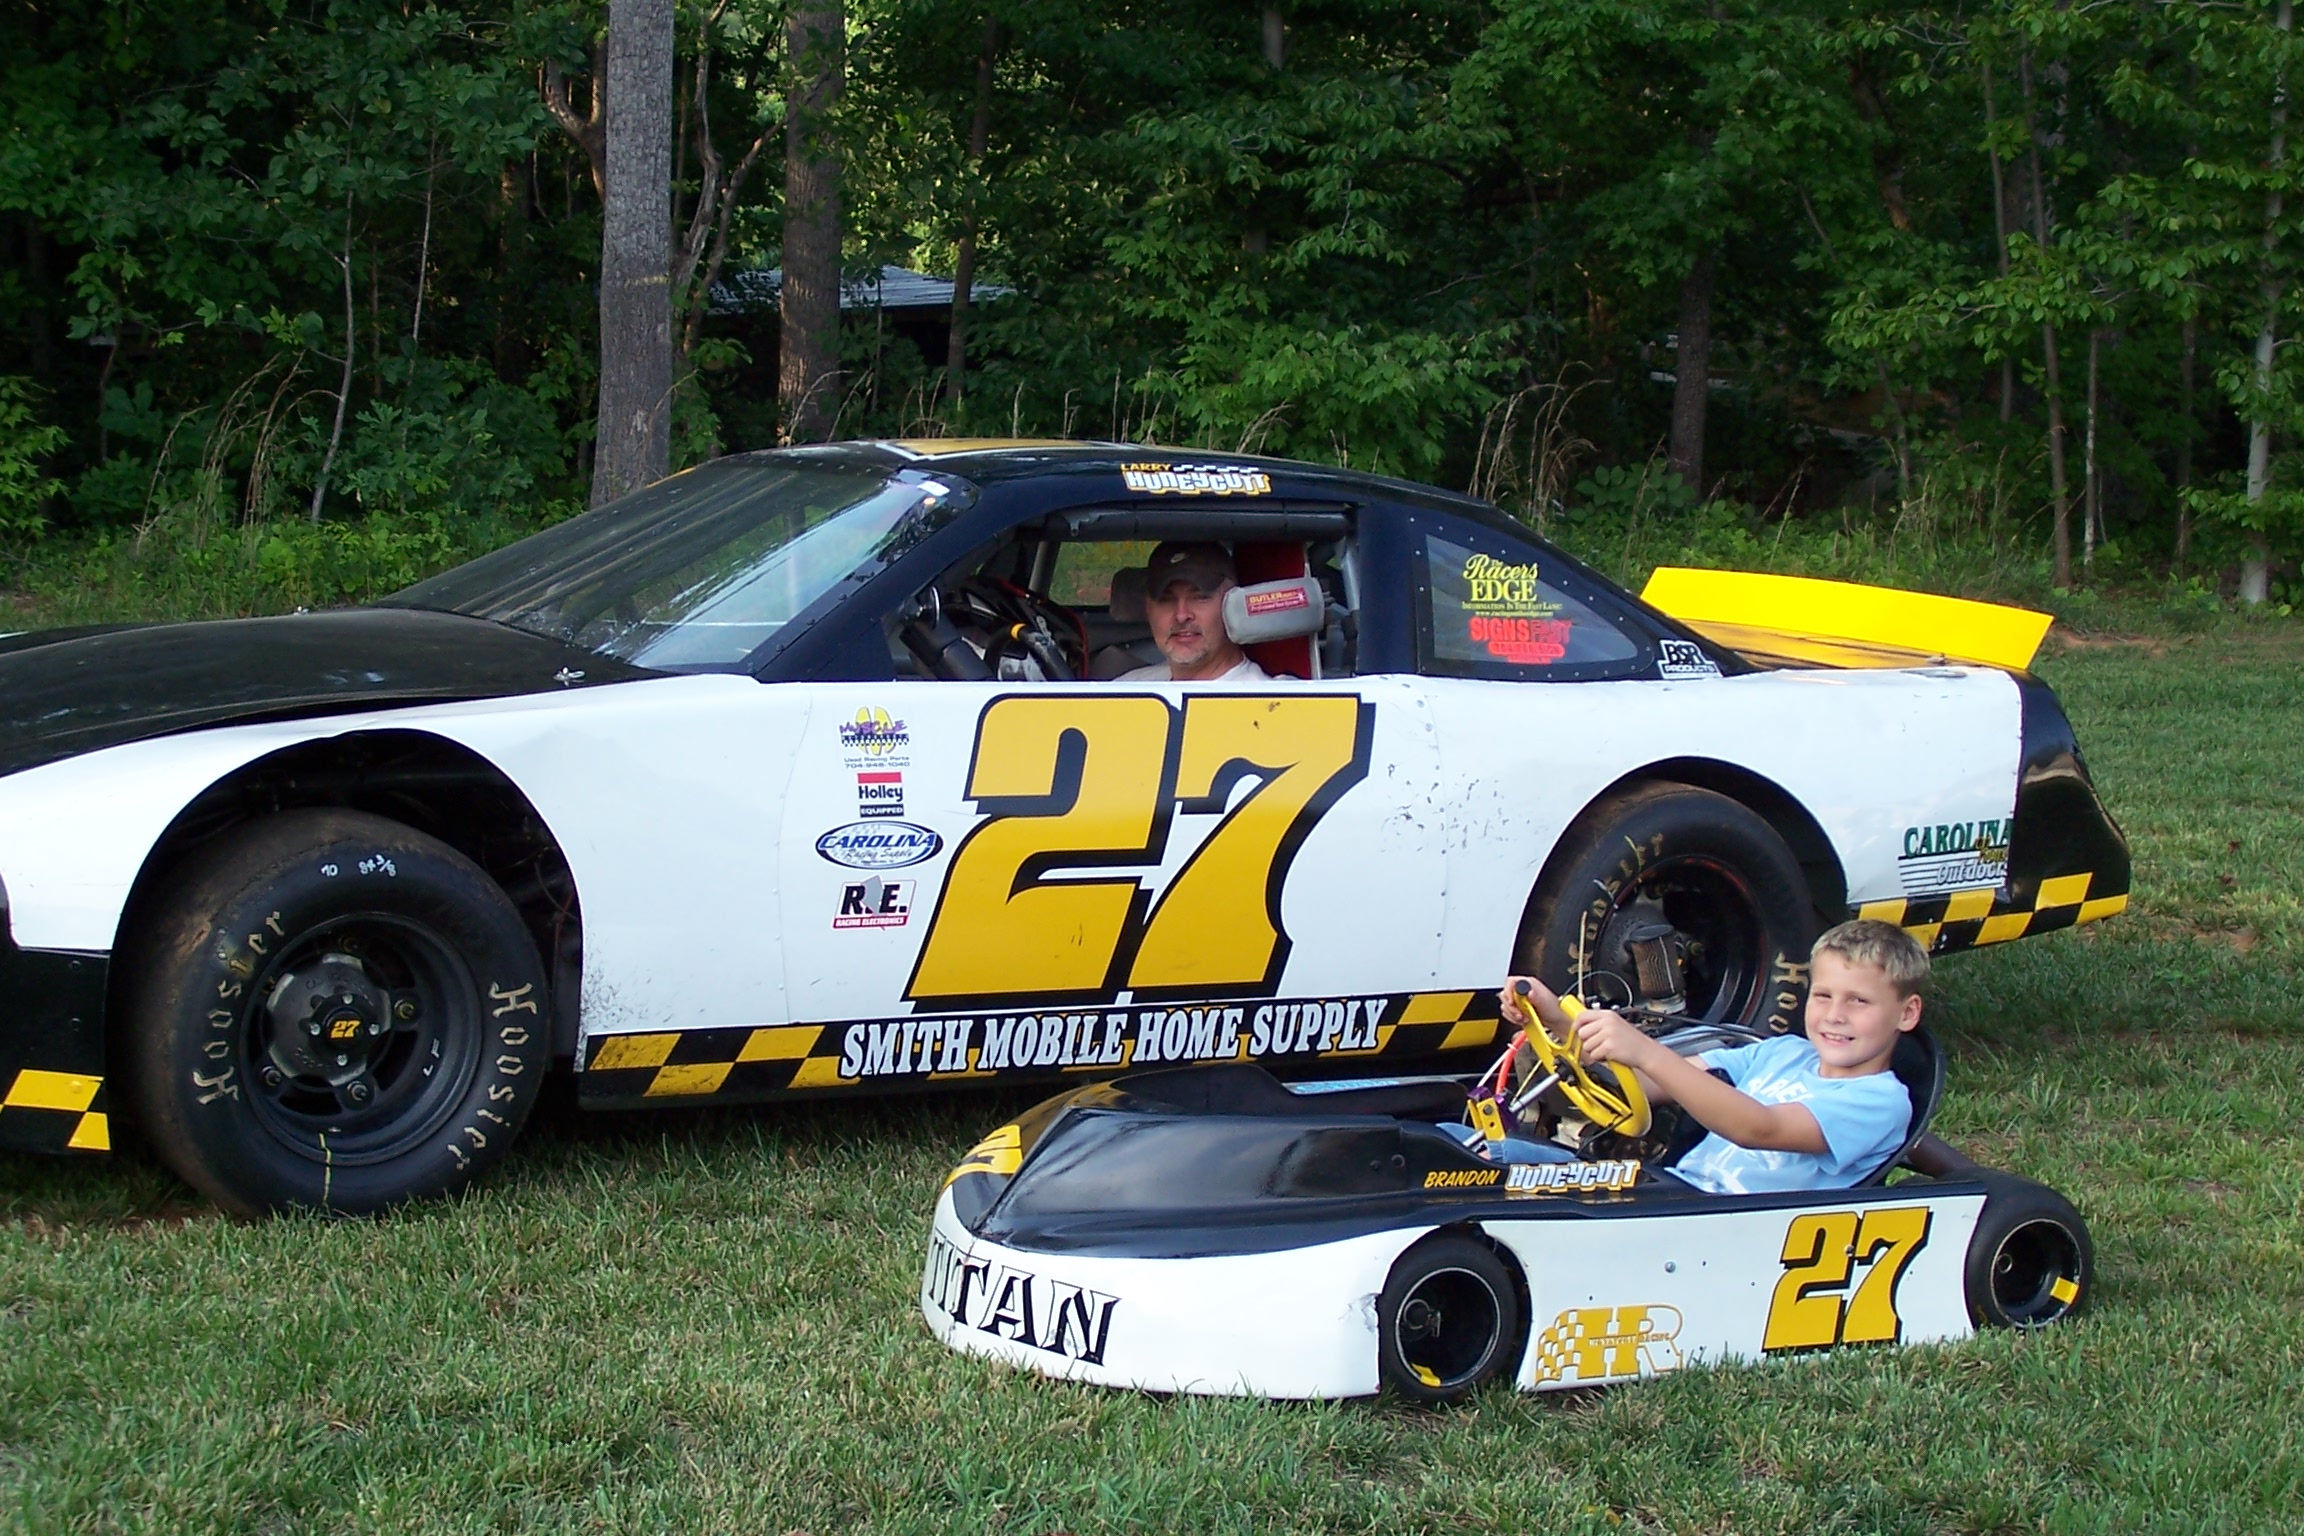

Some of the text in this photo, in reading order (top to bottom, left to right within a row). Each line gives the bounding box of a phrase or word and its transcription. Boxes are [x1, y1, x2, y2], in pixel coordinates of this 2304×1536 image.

[1120, 463, 1172, 471] LARRY
[1463, 554, 1539, 580] Racers
[1470, 580, 1538, 602] EDGE
[1663, 643, 1706, 666] BSR
[1663, 664, 1716, 674] PRODUCTS
[858, 785, 903, 802] Holley
[861, 806, 904, 815] EQUIPPED
[819, 834, 936, 849] CAROLINA
[902, 692, 1373, 1012] 27
[845, 849, 878, 859] Racing
[835, 916, 905, 927] RACING ELECTRONICS
[192, 910, 286, 1105] Hoosier
[330, 1019, 361, 1039] 27
[841, 998, 1389, 1077] SMITH MOBILE HOME SUPPLY
[446, 981, 538, 1170] Hoosier
[1423, 1169, 1501, 1189] BRANDON
[1762, 1206, 1931, 1353] 27
[928, 1229, 1121, 1366] TITAN
